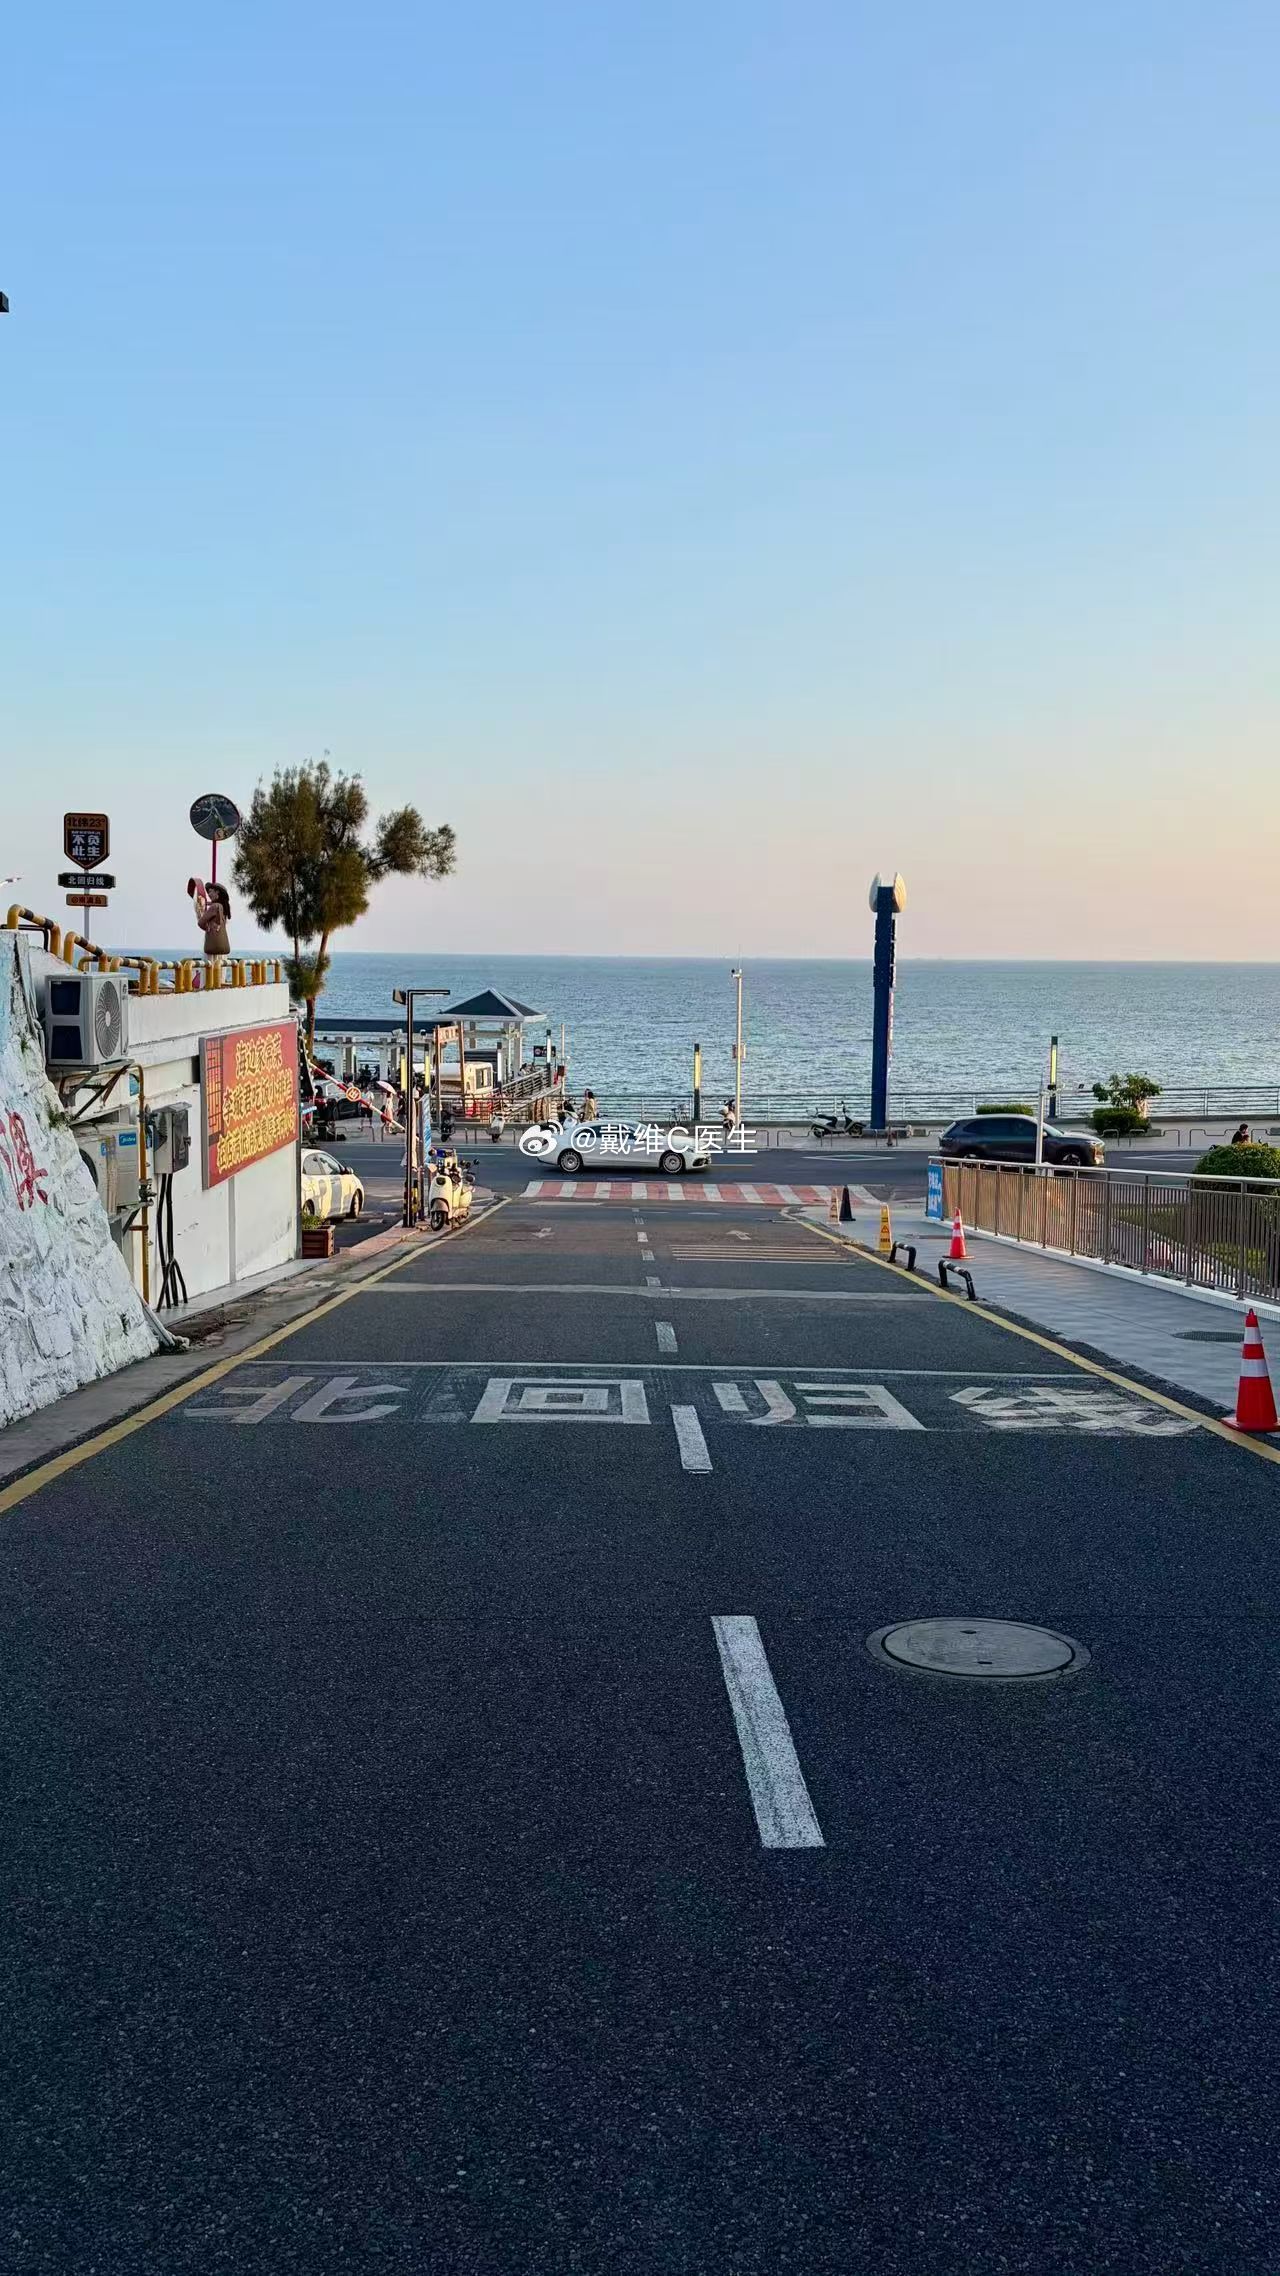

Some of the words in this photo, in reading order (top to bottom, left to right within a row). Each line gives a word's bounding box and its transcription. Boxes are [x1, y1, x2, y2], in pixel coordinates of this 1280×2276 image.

[72, 846, 101, 857] 此生
[68, 876, 105, 886] 北回归线
[236, 1032, 282, 1079] 海边家常菜
[183, 1376, 1202, 1436] 北回归线
